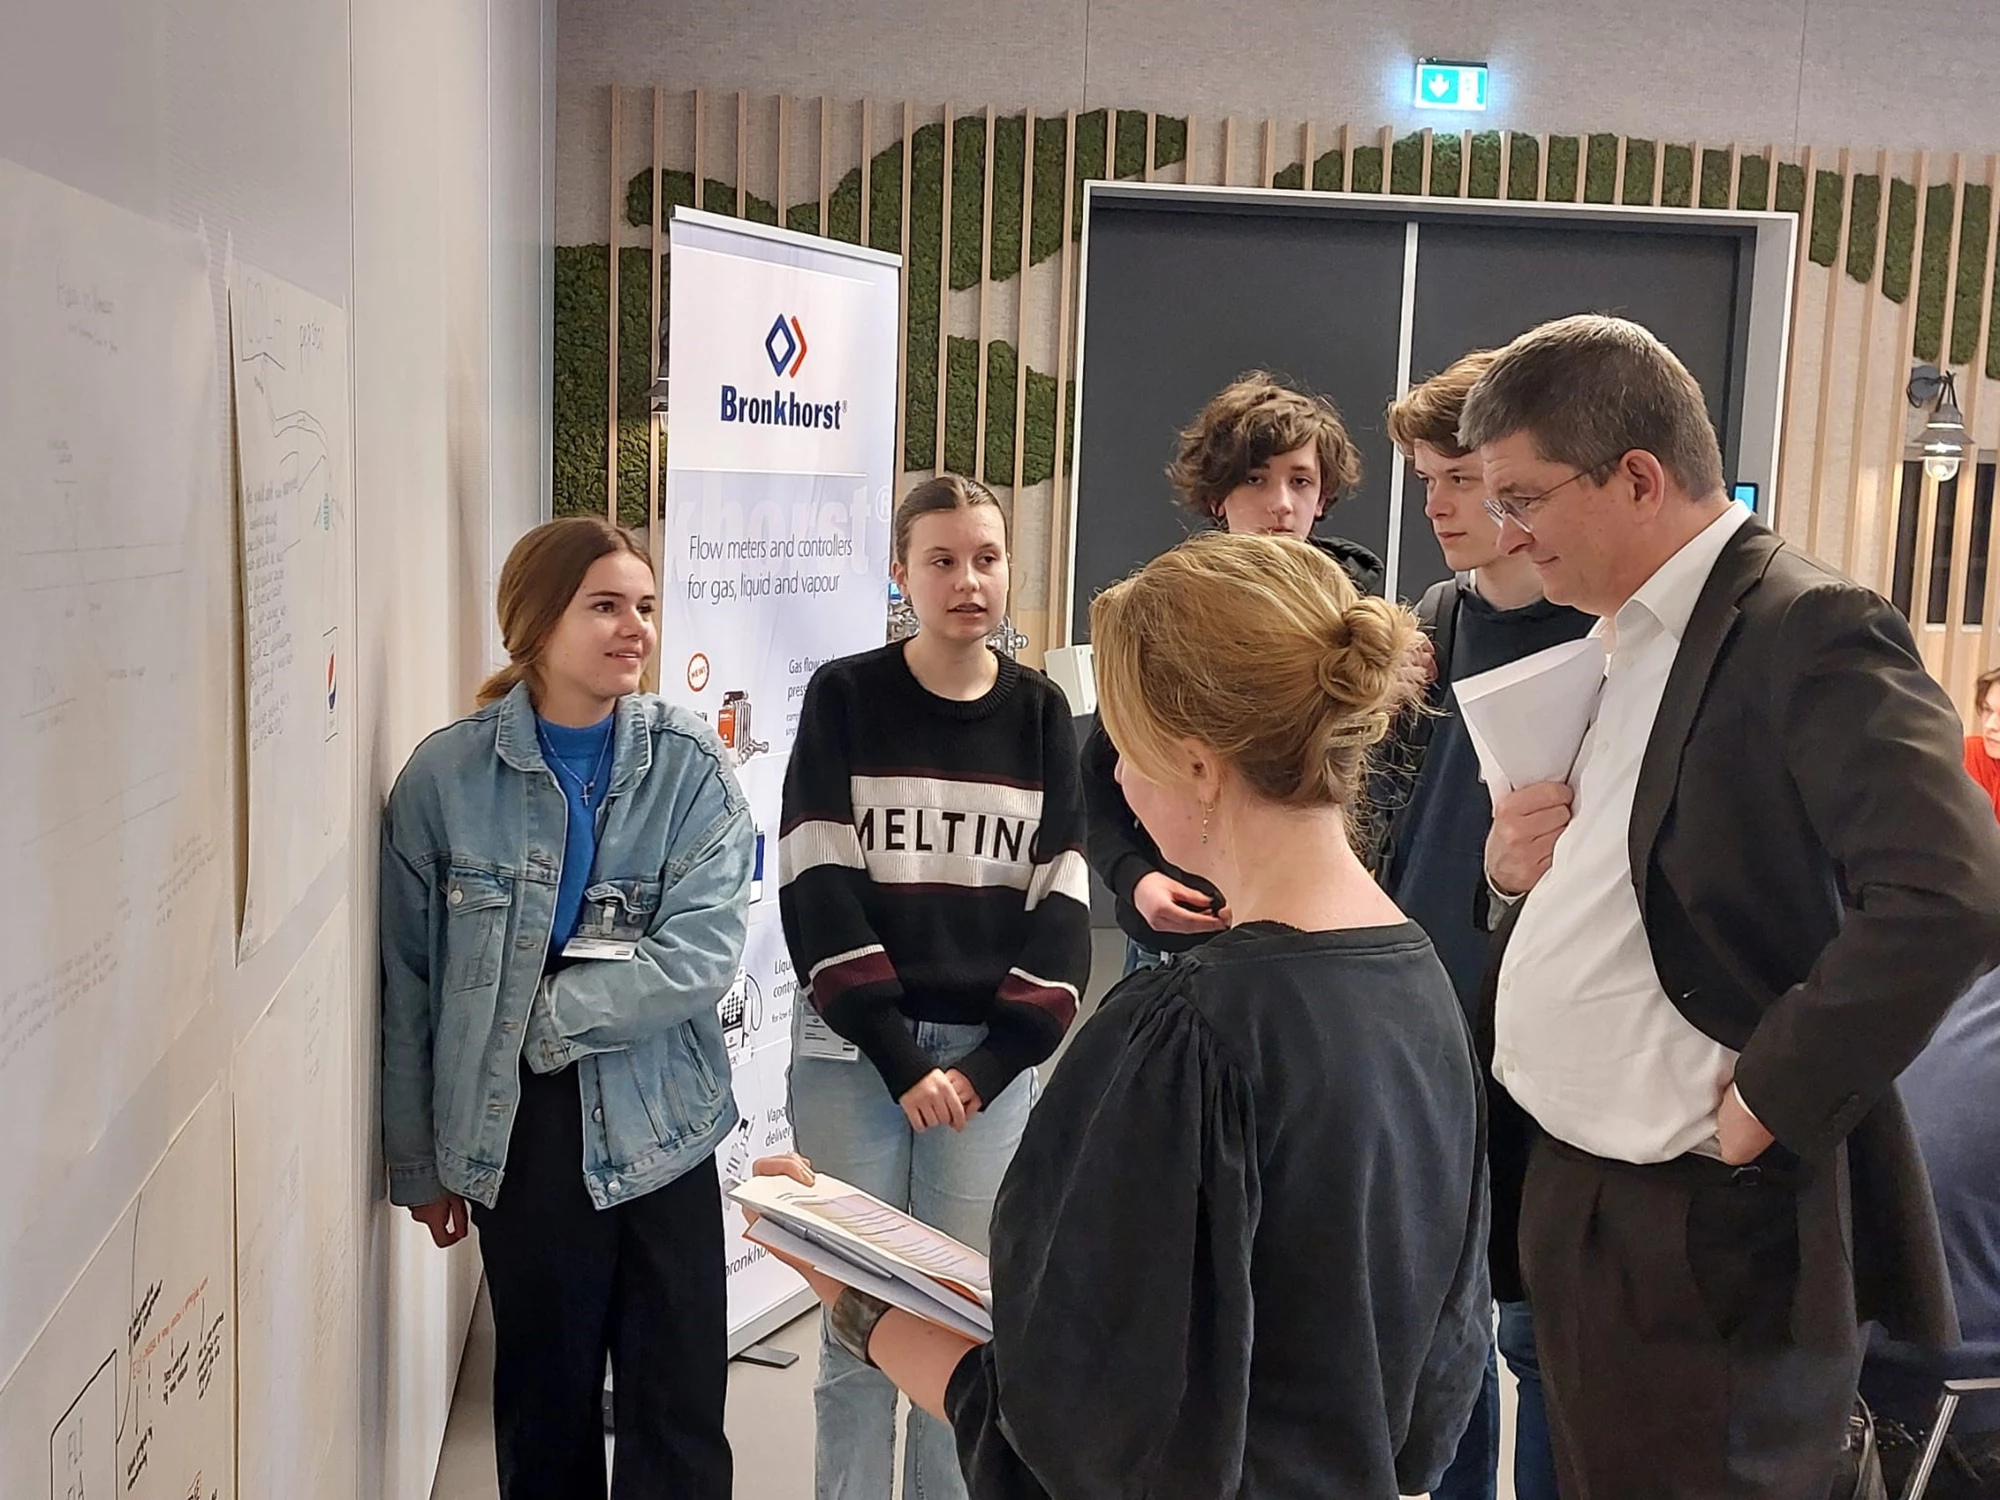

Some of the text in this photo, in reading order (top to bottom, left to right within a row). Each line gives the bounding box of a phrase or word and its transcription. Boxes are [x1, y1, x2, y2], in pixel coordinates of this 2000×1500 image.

[689, 533, 853, 560] Flow meters and controllers
[687, 570, 841, 606] for gas, liquid and vapour
[788, 658, 803, 674] Gas
